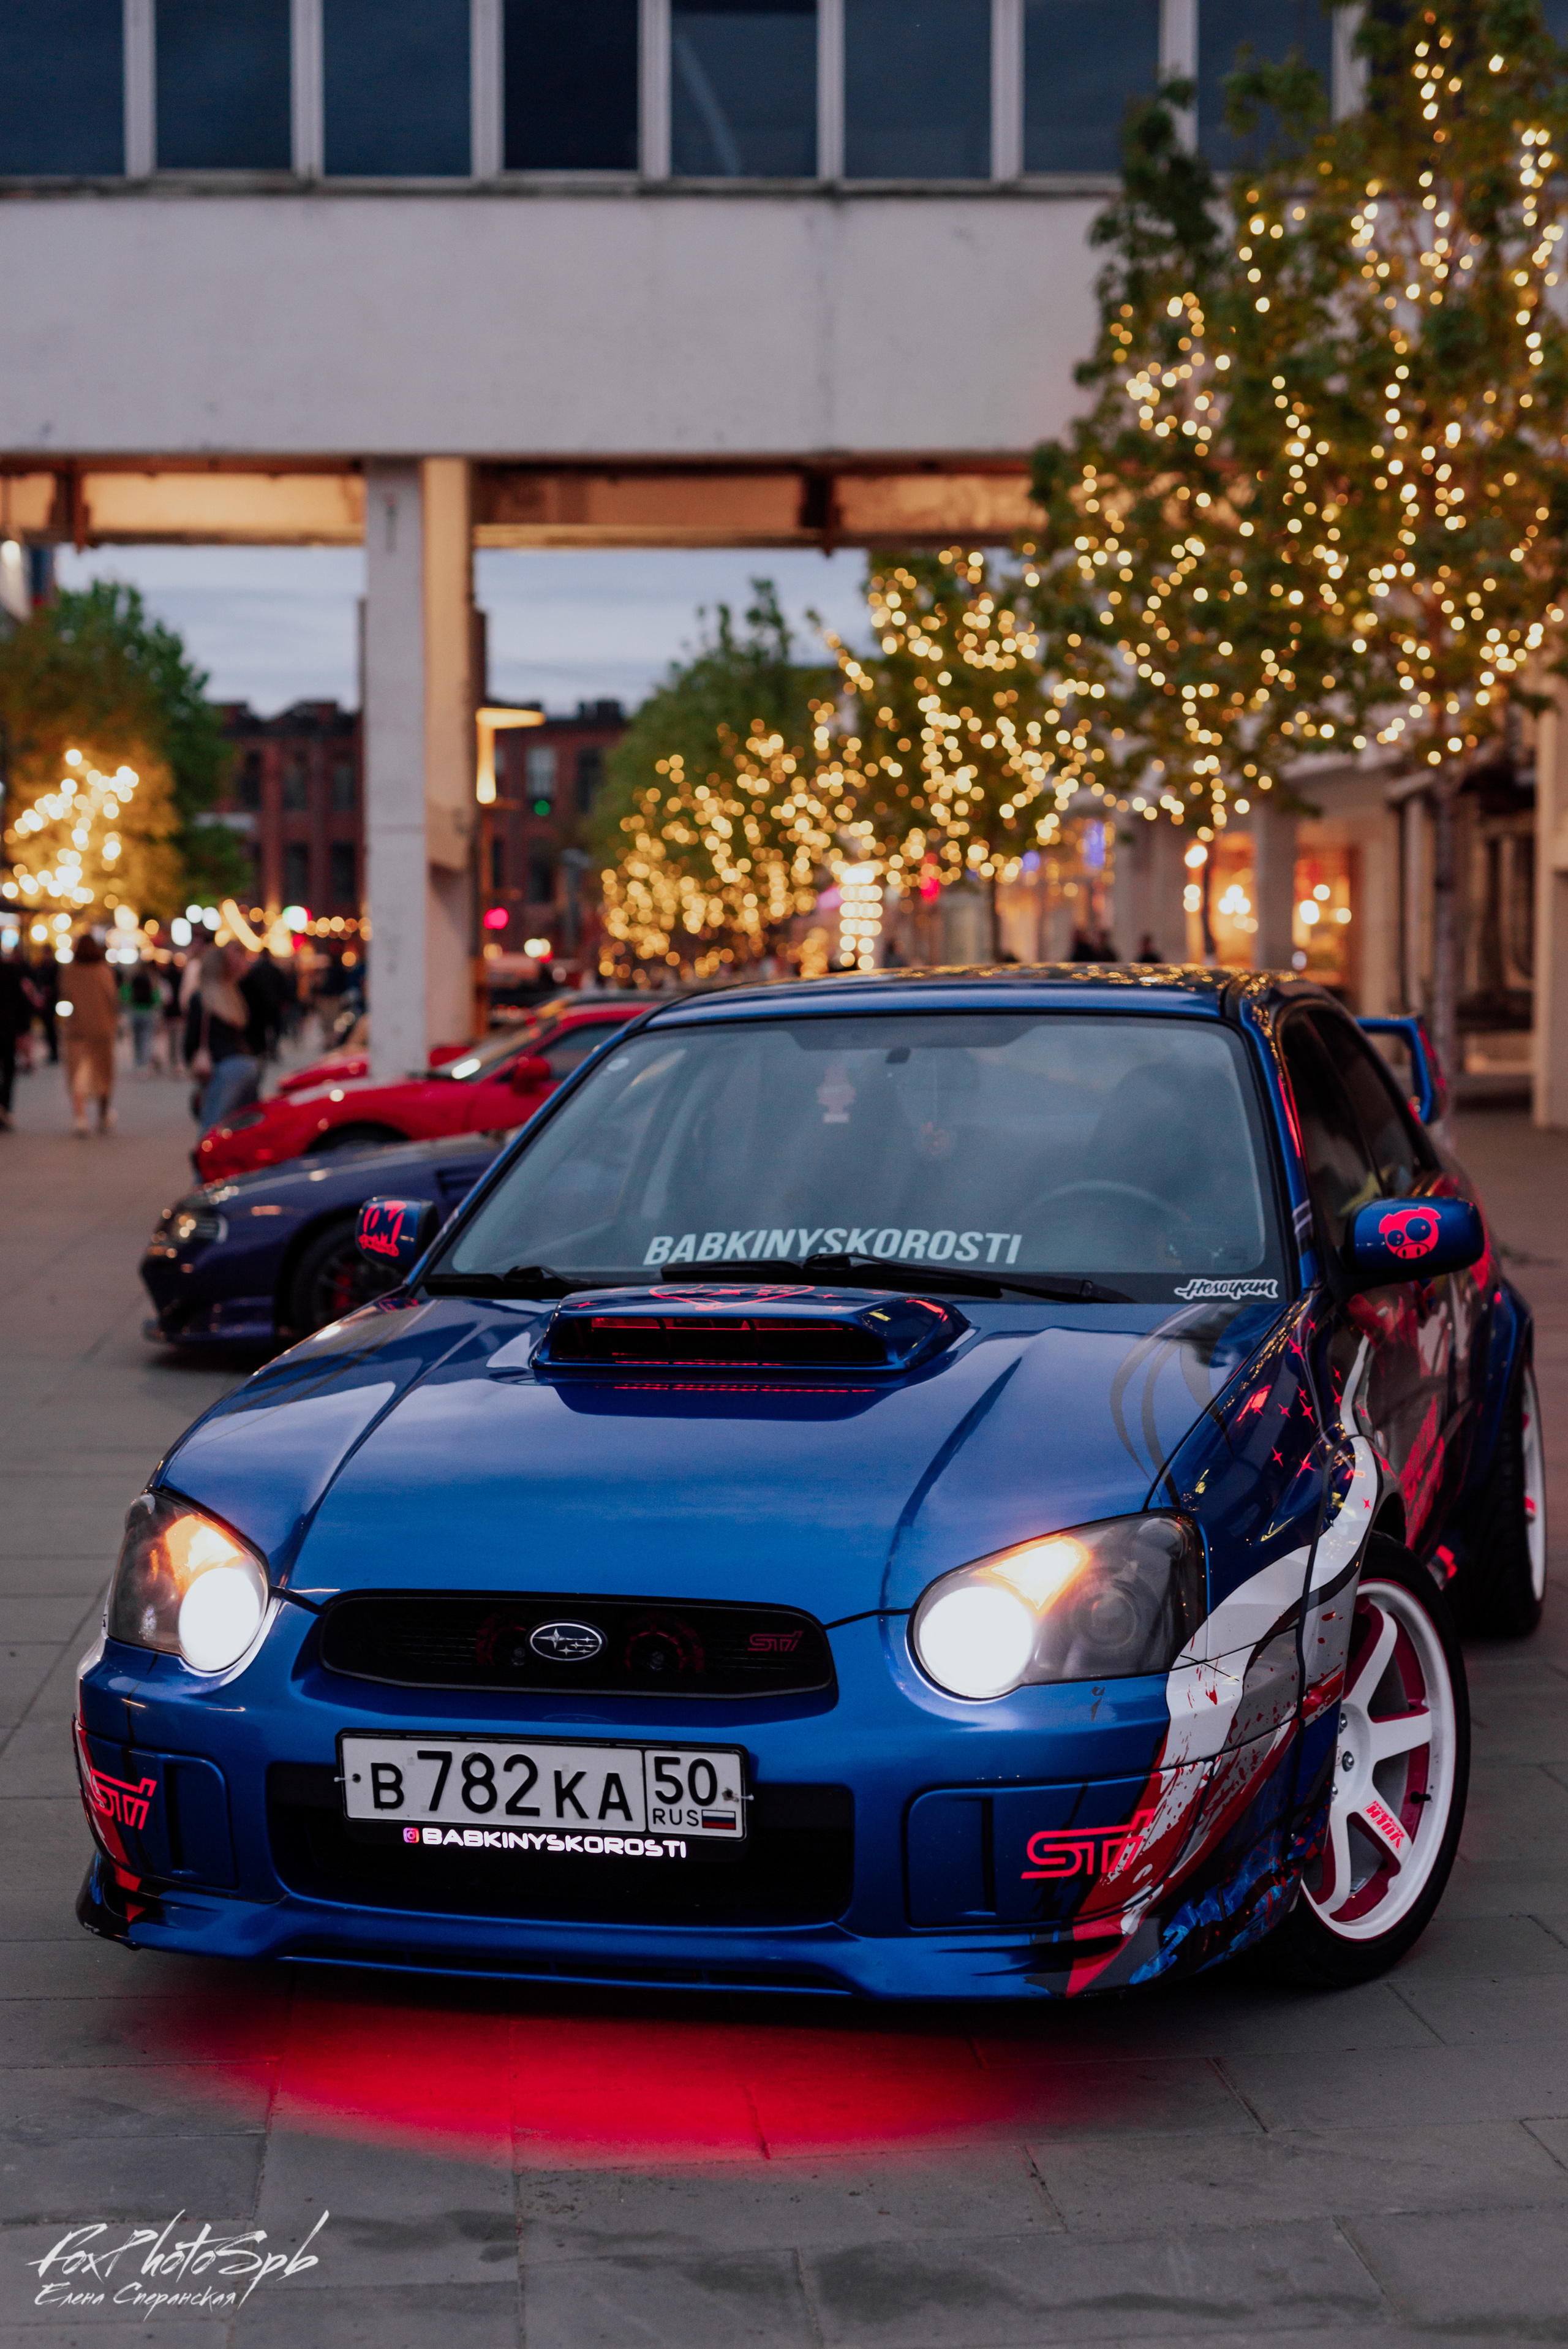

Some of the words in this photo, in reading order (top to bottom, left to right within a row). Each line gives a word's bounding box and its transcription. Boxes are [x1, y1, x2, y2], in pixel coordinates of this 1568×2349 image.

[643, 1228, 1022, 1266] BABKINYSKOROSTI
[654, 1755, 718, 1807] 50
[652, 1808, 699, 1827] RUS
[422, 1827, 687, 1858] BABKINYSKOROSTI
